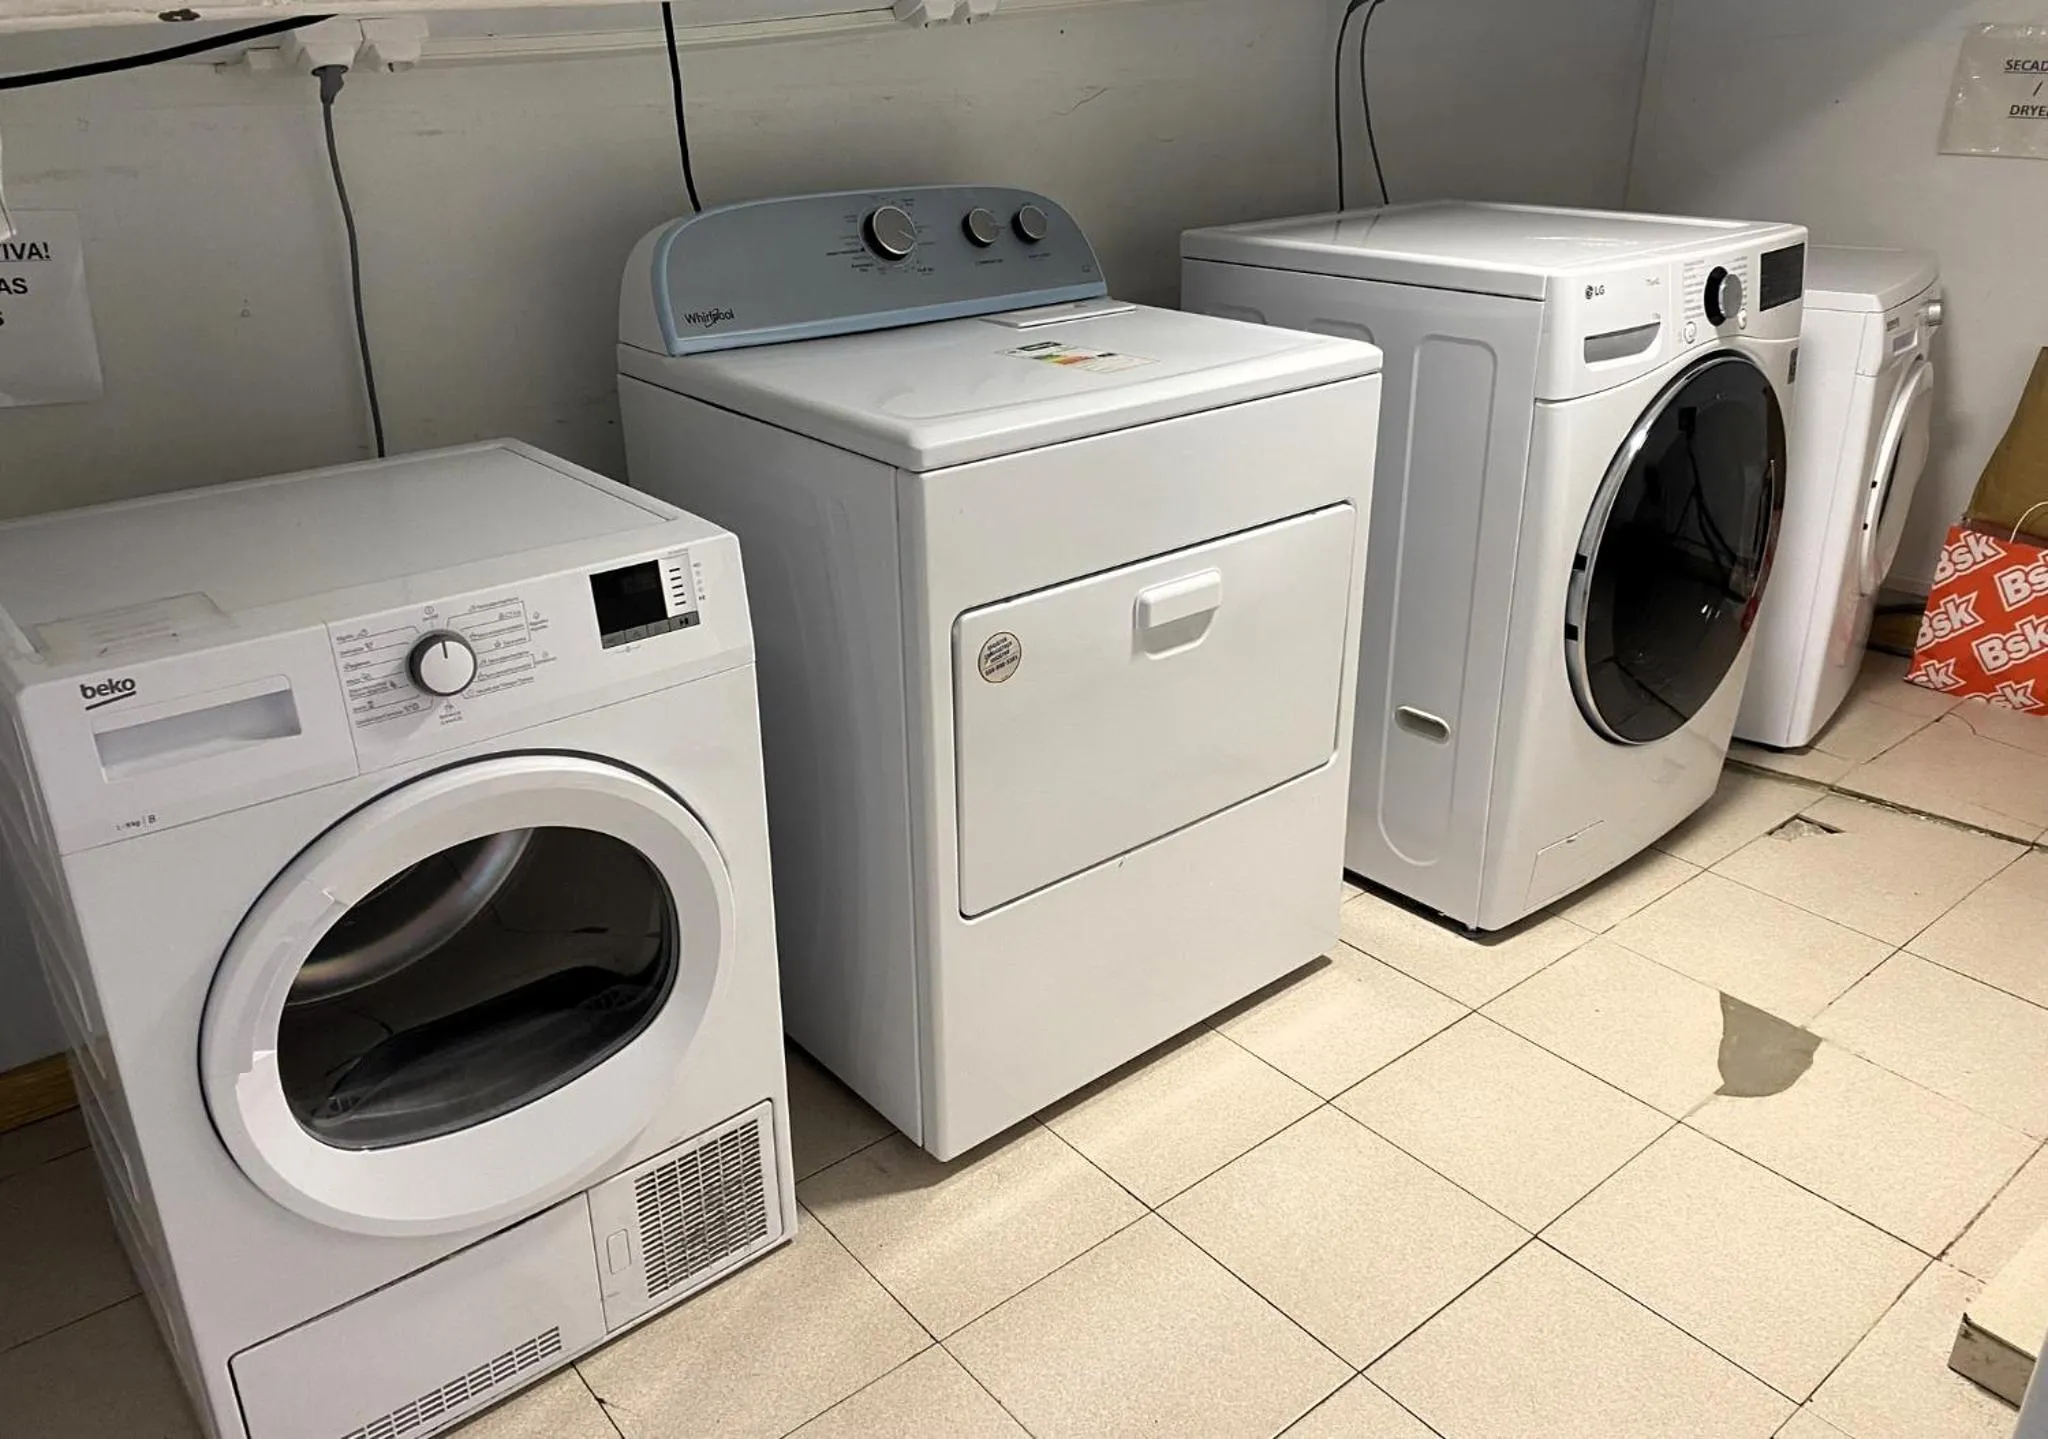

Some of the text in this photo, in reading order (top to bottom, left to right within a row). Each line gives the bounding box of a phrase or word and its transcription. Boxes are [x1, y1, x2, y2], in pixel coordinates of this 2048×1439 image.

[2009, 104, 2048, 116] DRYE
[0, 242, 50, 259] IVA!
[684, 308, 735, 328] Whirlpool
[80, 678, 136, 699] beko
